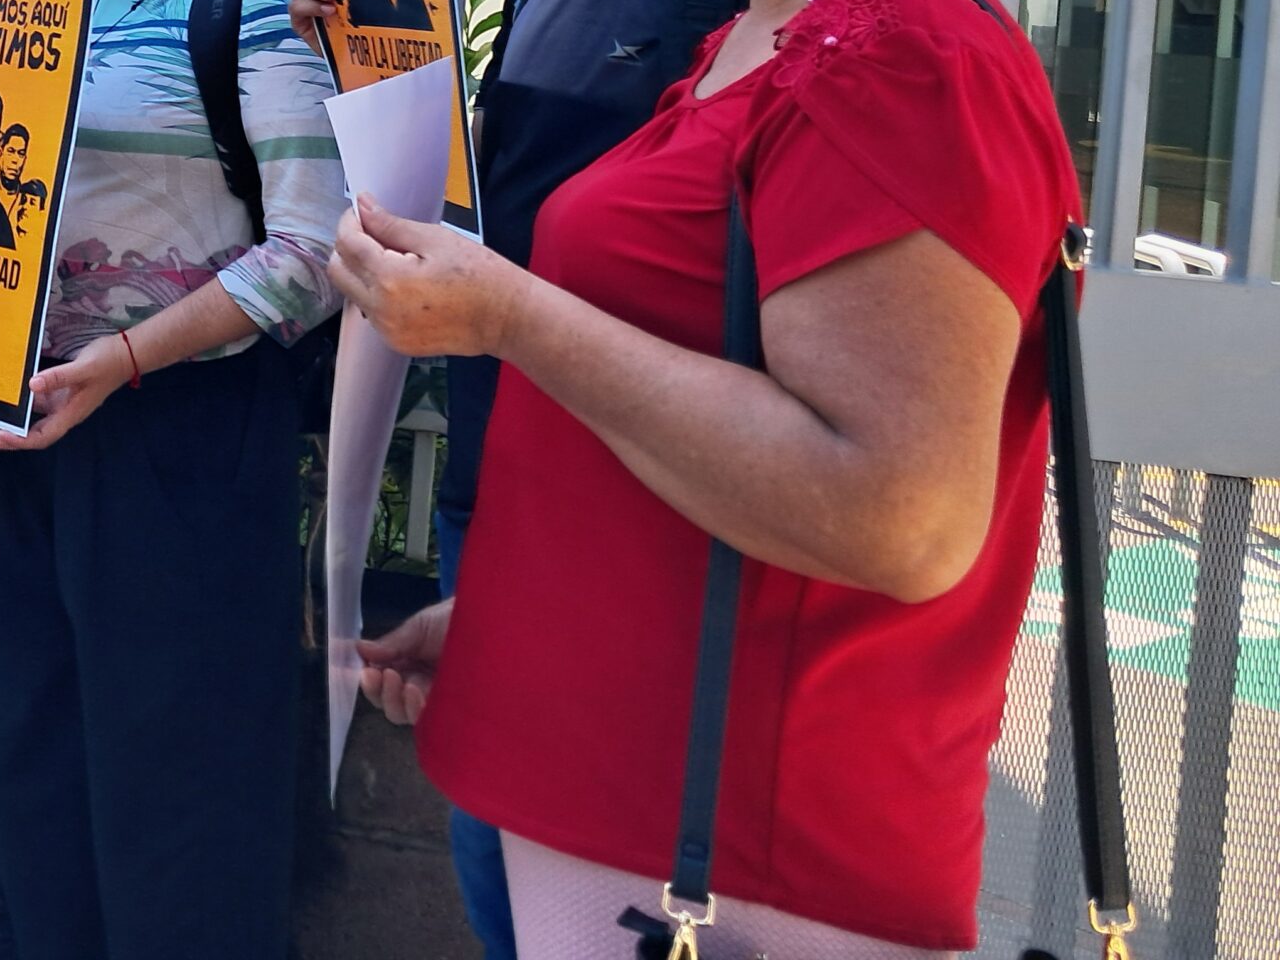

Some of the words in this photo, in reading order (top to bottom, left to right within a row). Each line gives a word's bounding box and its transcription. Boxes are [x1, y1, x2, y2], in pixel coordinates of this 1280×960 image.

[31, 0, 70, 29] AQUÍ
[346, 34, 373, 67] POR
[371, 36, 389, 69] LA
